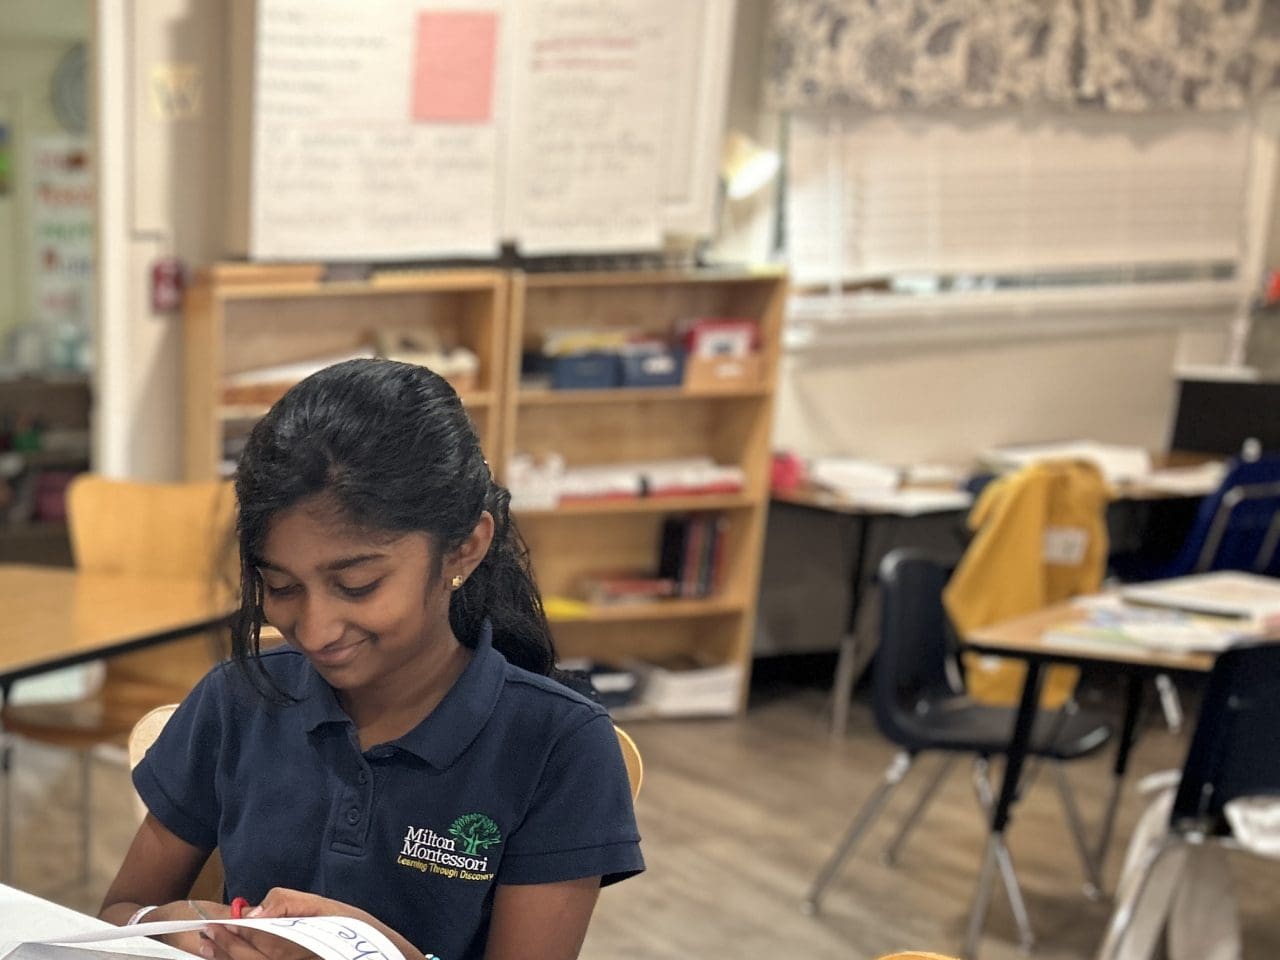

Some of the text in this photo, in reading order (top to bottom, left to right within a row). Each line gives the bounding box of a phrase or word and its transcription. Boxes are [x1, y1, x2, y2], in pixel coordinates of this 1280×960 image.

[404, 825, 456, 852] Milton
[397, 854, 429, 873] Learning
[429, 862, 459, 879] Through
[400, 839, 489, 872] Montessori
